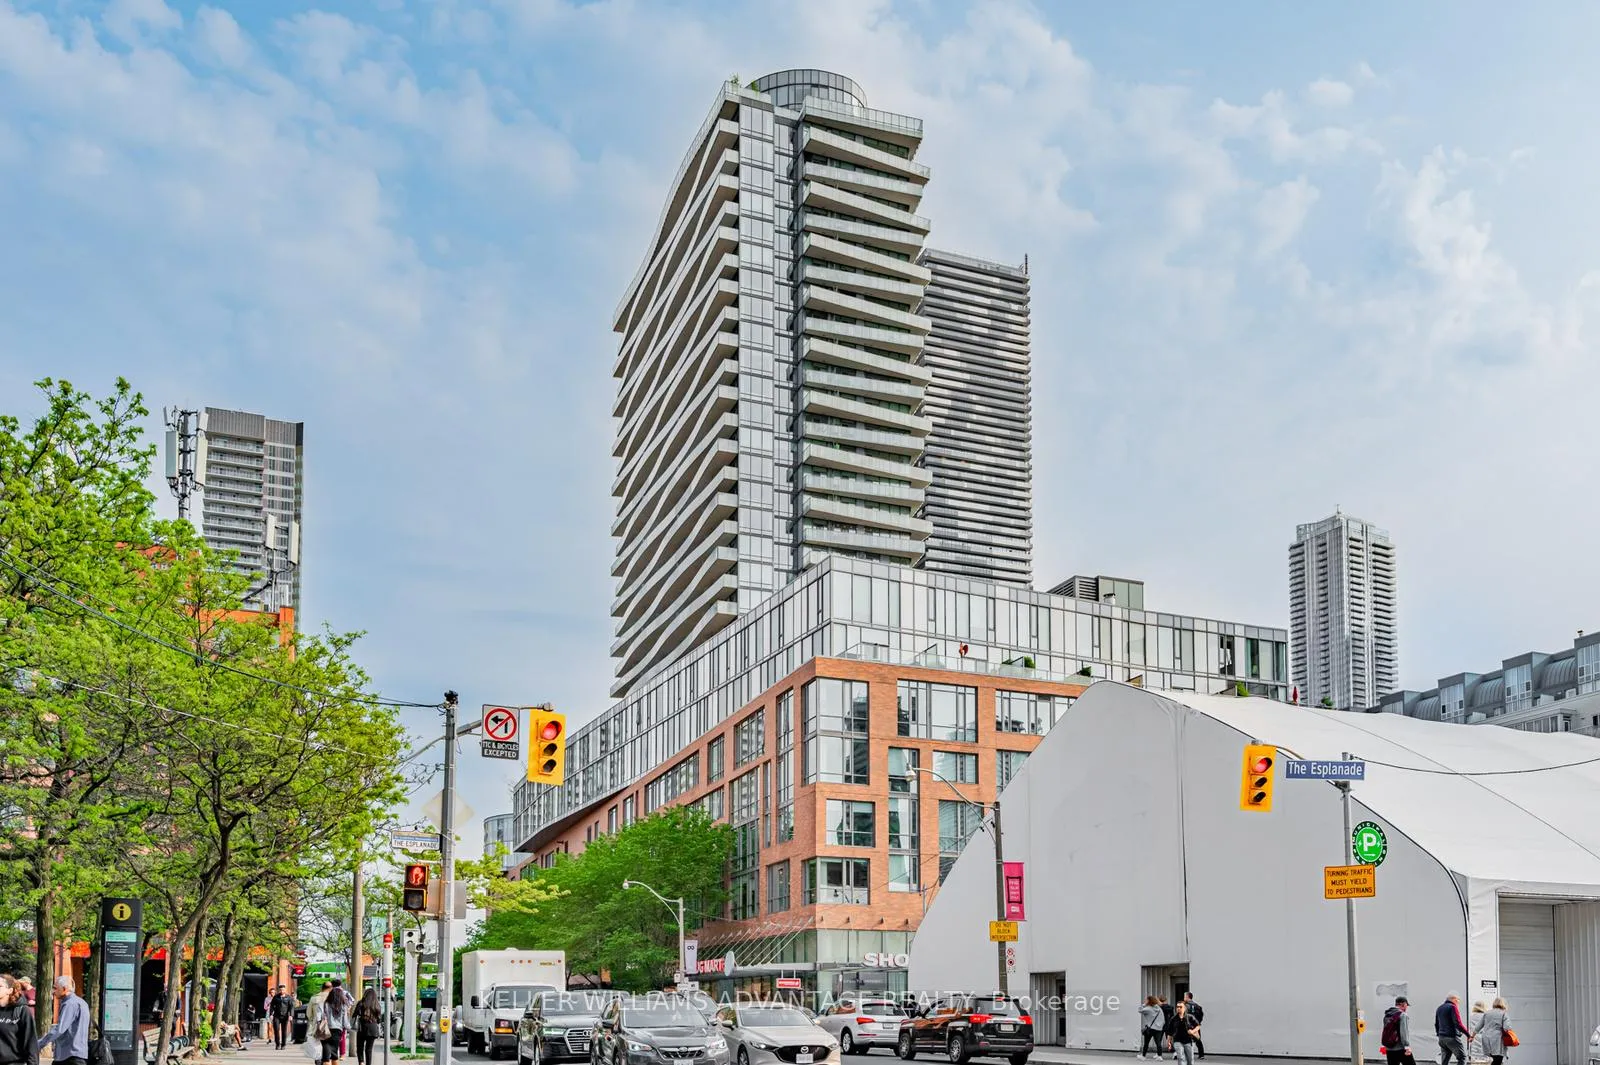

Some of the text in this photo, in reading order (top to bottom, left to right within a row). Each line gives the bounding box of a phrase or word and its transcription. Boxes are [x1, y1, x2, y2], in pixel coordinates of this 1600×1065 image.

[484, 749, 517, 758] EXCEPTED
[1288, 762, 1363, 778] The Esplanade
[1352, 822, 1386, 843] MUNICIPAL
[405, 841, 437, 849] ESPLANADE
[1363, 832, 1377, 852] P
[1350, 868, 1372, 876] TRAFFIC
[1336, 887, 1372, 895] PEDESTRIANS
[861, 952, 909, 967] SHO
